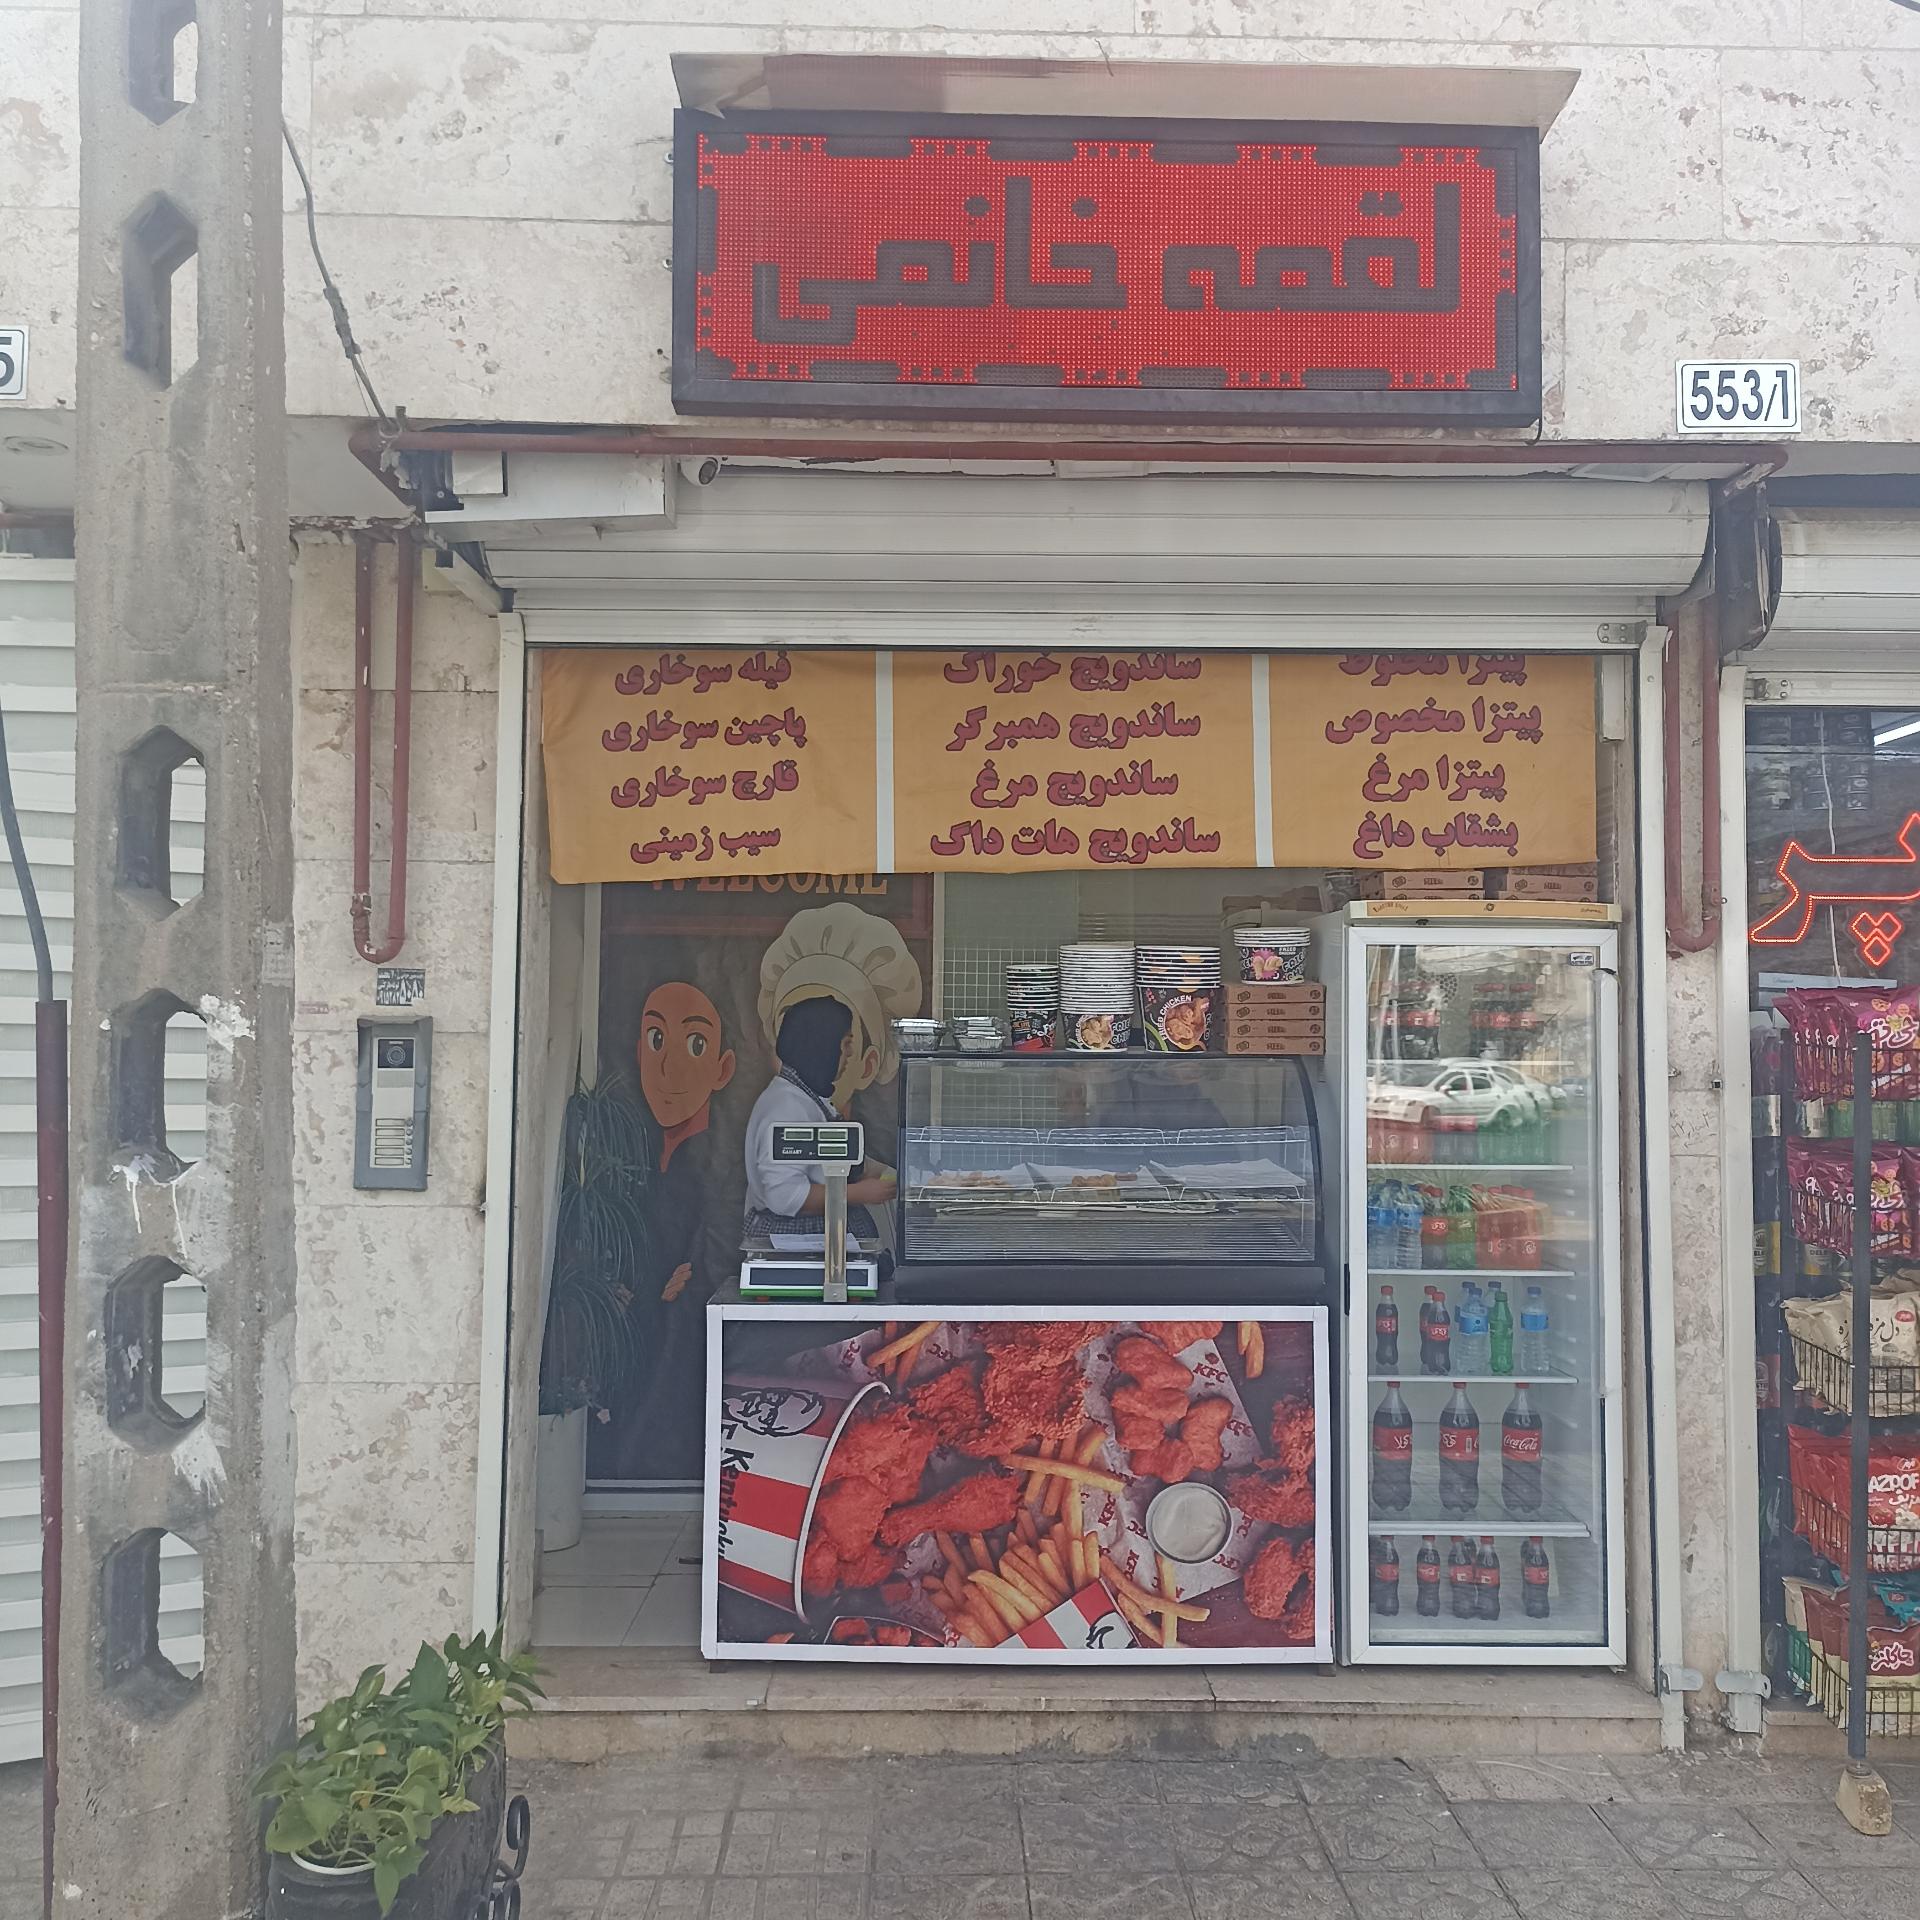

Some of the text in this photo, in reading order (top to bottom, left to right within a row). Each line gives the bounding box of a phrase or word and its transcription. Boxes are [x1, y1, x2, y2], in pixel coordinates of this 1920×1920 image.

[752, 175, 1461, 346] لقمه خانمی
[1690, 369, 1789, 422] 553/1
[614, 650, 791, 695] فیله سوخاری
[602, 707, 808, 752] پاچین سوخاری
[1069, 701, 1201, 749] ساندویچ
[1325, 696, 1544, 744] پیتزا مخصوص
[611, 760, 800, 808] قارچ سوخاری
[970, 759, 1179, 808] ساندویچ مرغ
[1362, 753, 1508, 802] پیتزا مرغ
[630, 826, 781, 864] سیب زمینی
[930, 817, 1221, 864] ساندویچ هات داگ
[1353, 811, 1519, 859] بشقاب داغ
[1160, 995, 1192, 1016] CHICKEN
[1193, 1363, 1229, 1384] KFC
[1098, 1493, 1117, 1527] KFC
